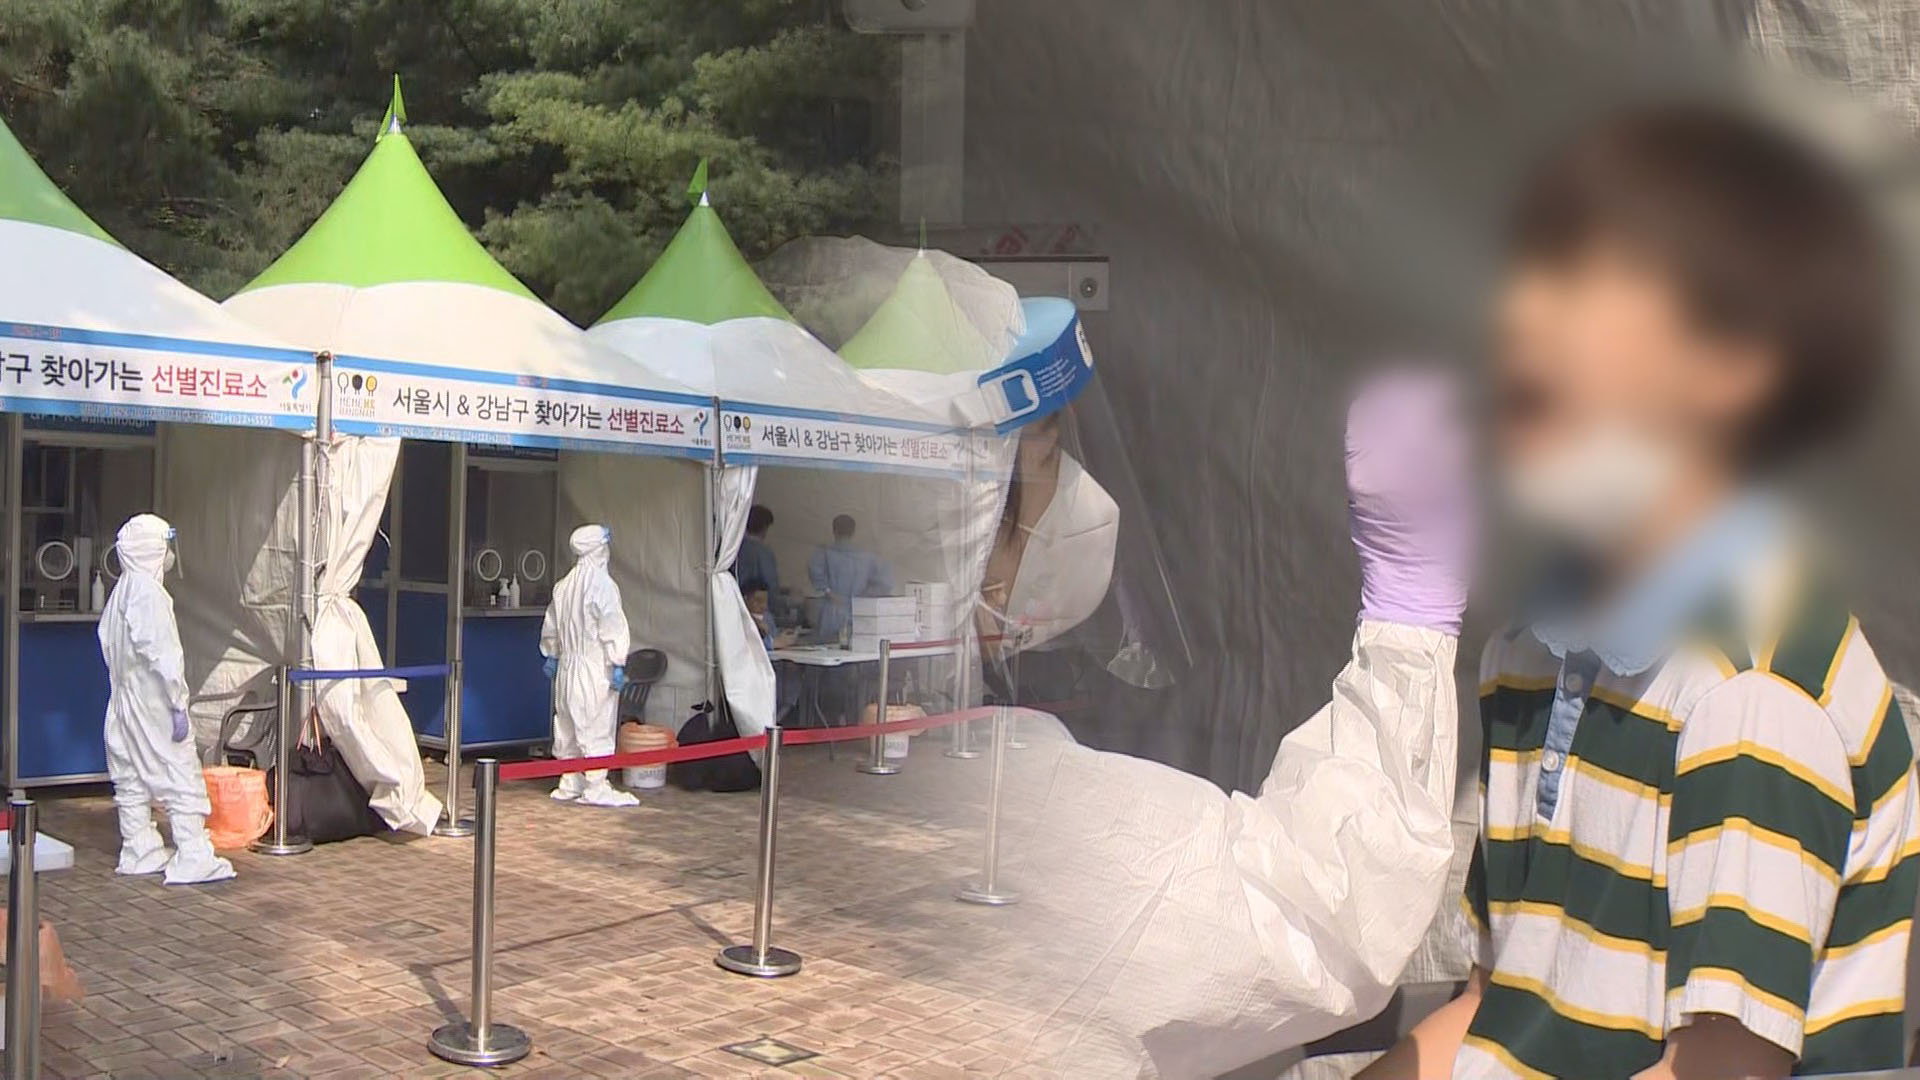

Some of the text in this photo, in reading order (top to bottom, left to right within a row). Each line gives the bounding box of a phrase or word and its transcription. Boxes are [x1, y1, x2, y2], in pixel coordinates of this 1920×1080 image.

[0, 351, 267, 398] 구 찾아가는 선별진료소
[393, 386, 450, 417] 서울시
[457, 394, 470, 416] &
[475, 394, 529, 422] 강남구
[534, 400, 602, 430] 찾아가는
[607, 408, 685, 435] 선별진료소
[762, 425, 800, 448] 서울시
[804, 430, 813, 447] &
[816, 429, 853, 452] 강남구
[854, 432, 897, 457] 찾아가는
[901, 439, 948, 460] 선별진료소
